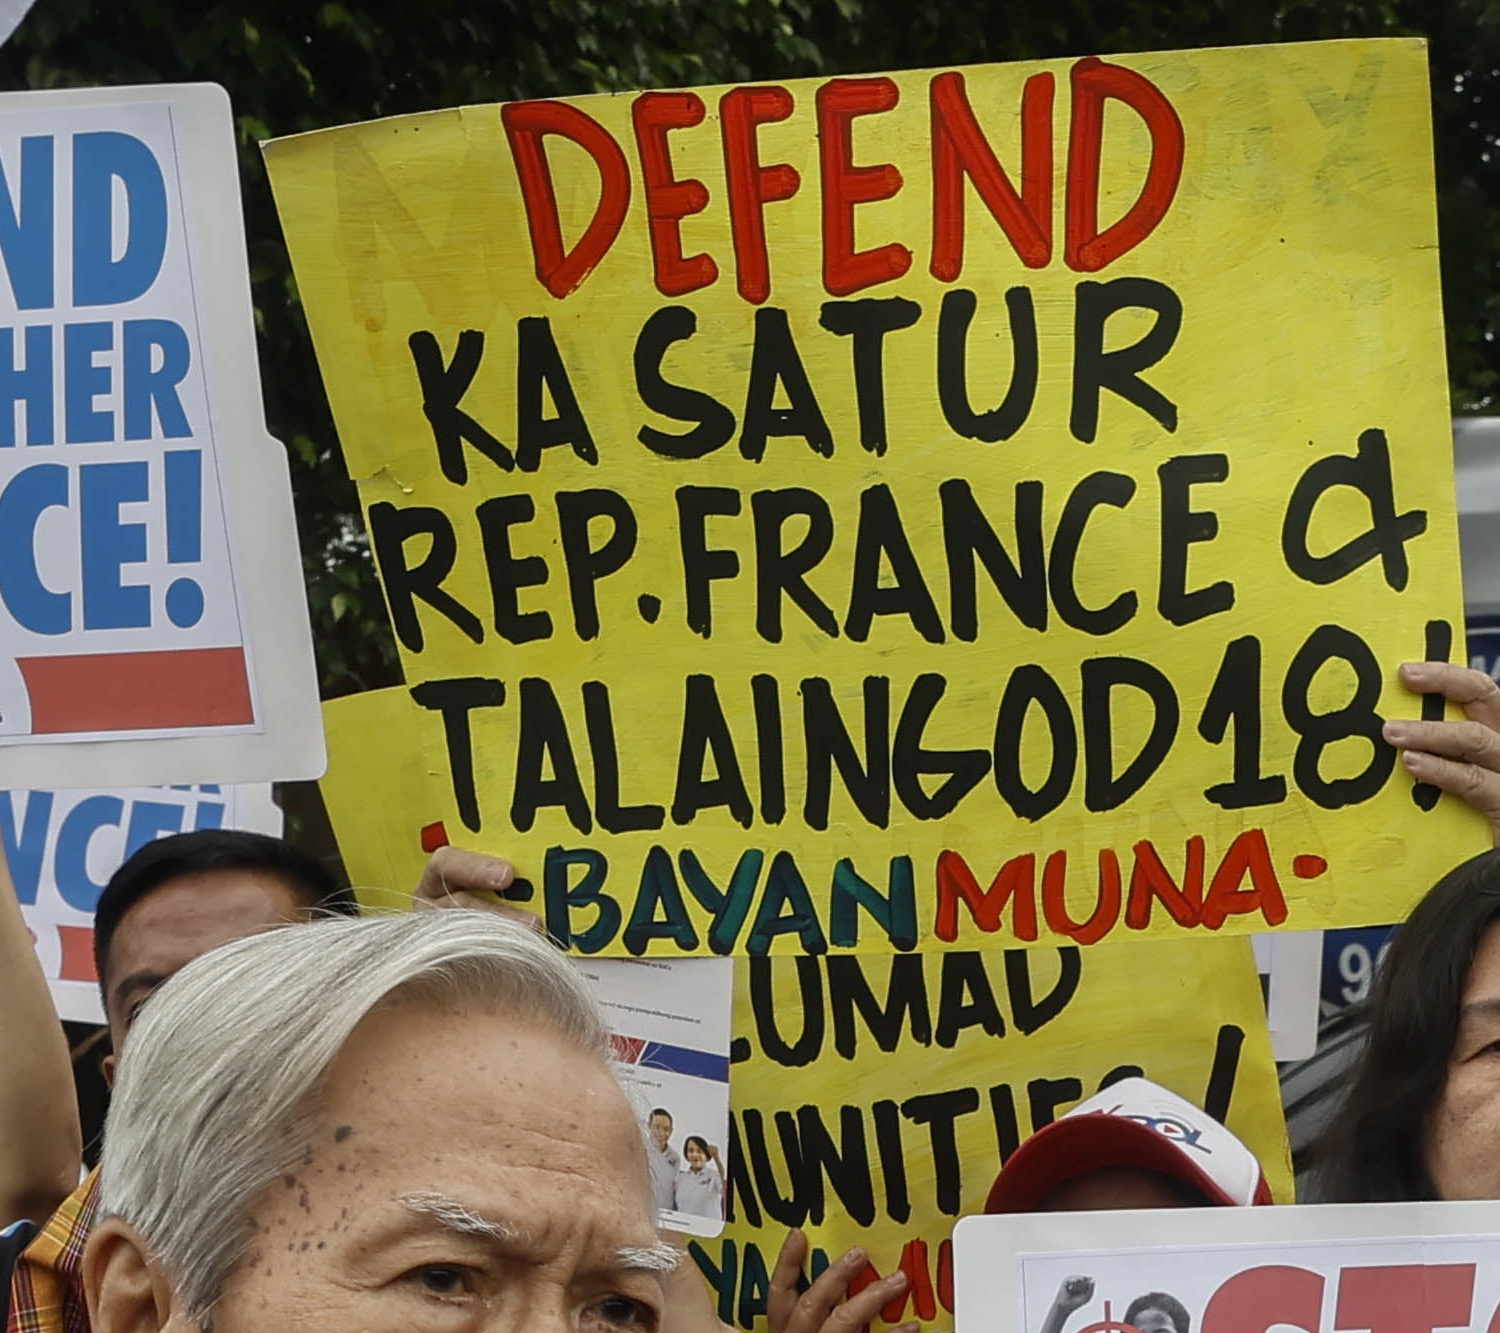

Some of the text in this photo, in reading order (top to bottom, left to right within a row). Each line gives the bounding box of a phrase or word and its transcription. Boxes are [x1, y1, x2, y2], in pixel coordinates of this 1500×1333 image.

[502, 56, 1185, 302] DEFEND
[409, 277, 1184, 486] KA SATUR
[410, 618, 1452, 834] TALAINGOD 18!
[727, 945, 1082, 1068] UMAD
